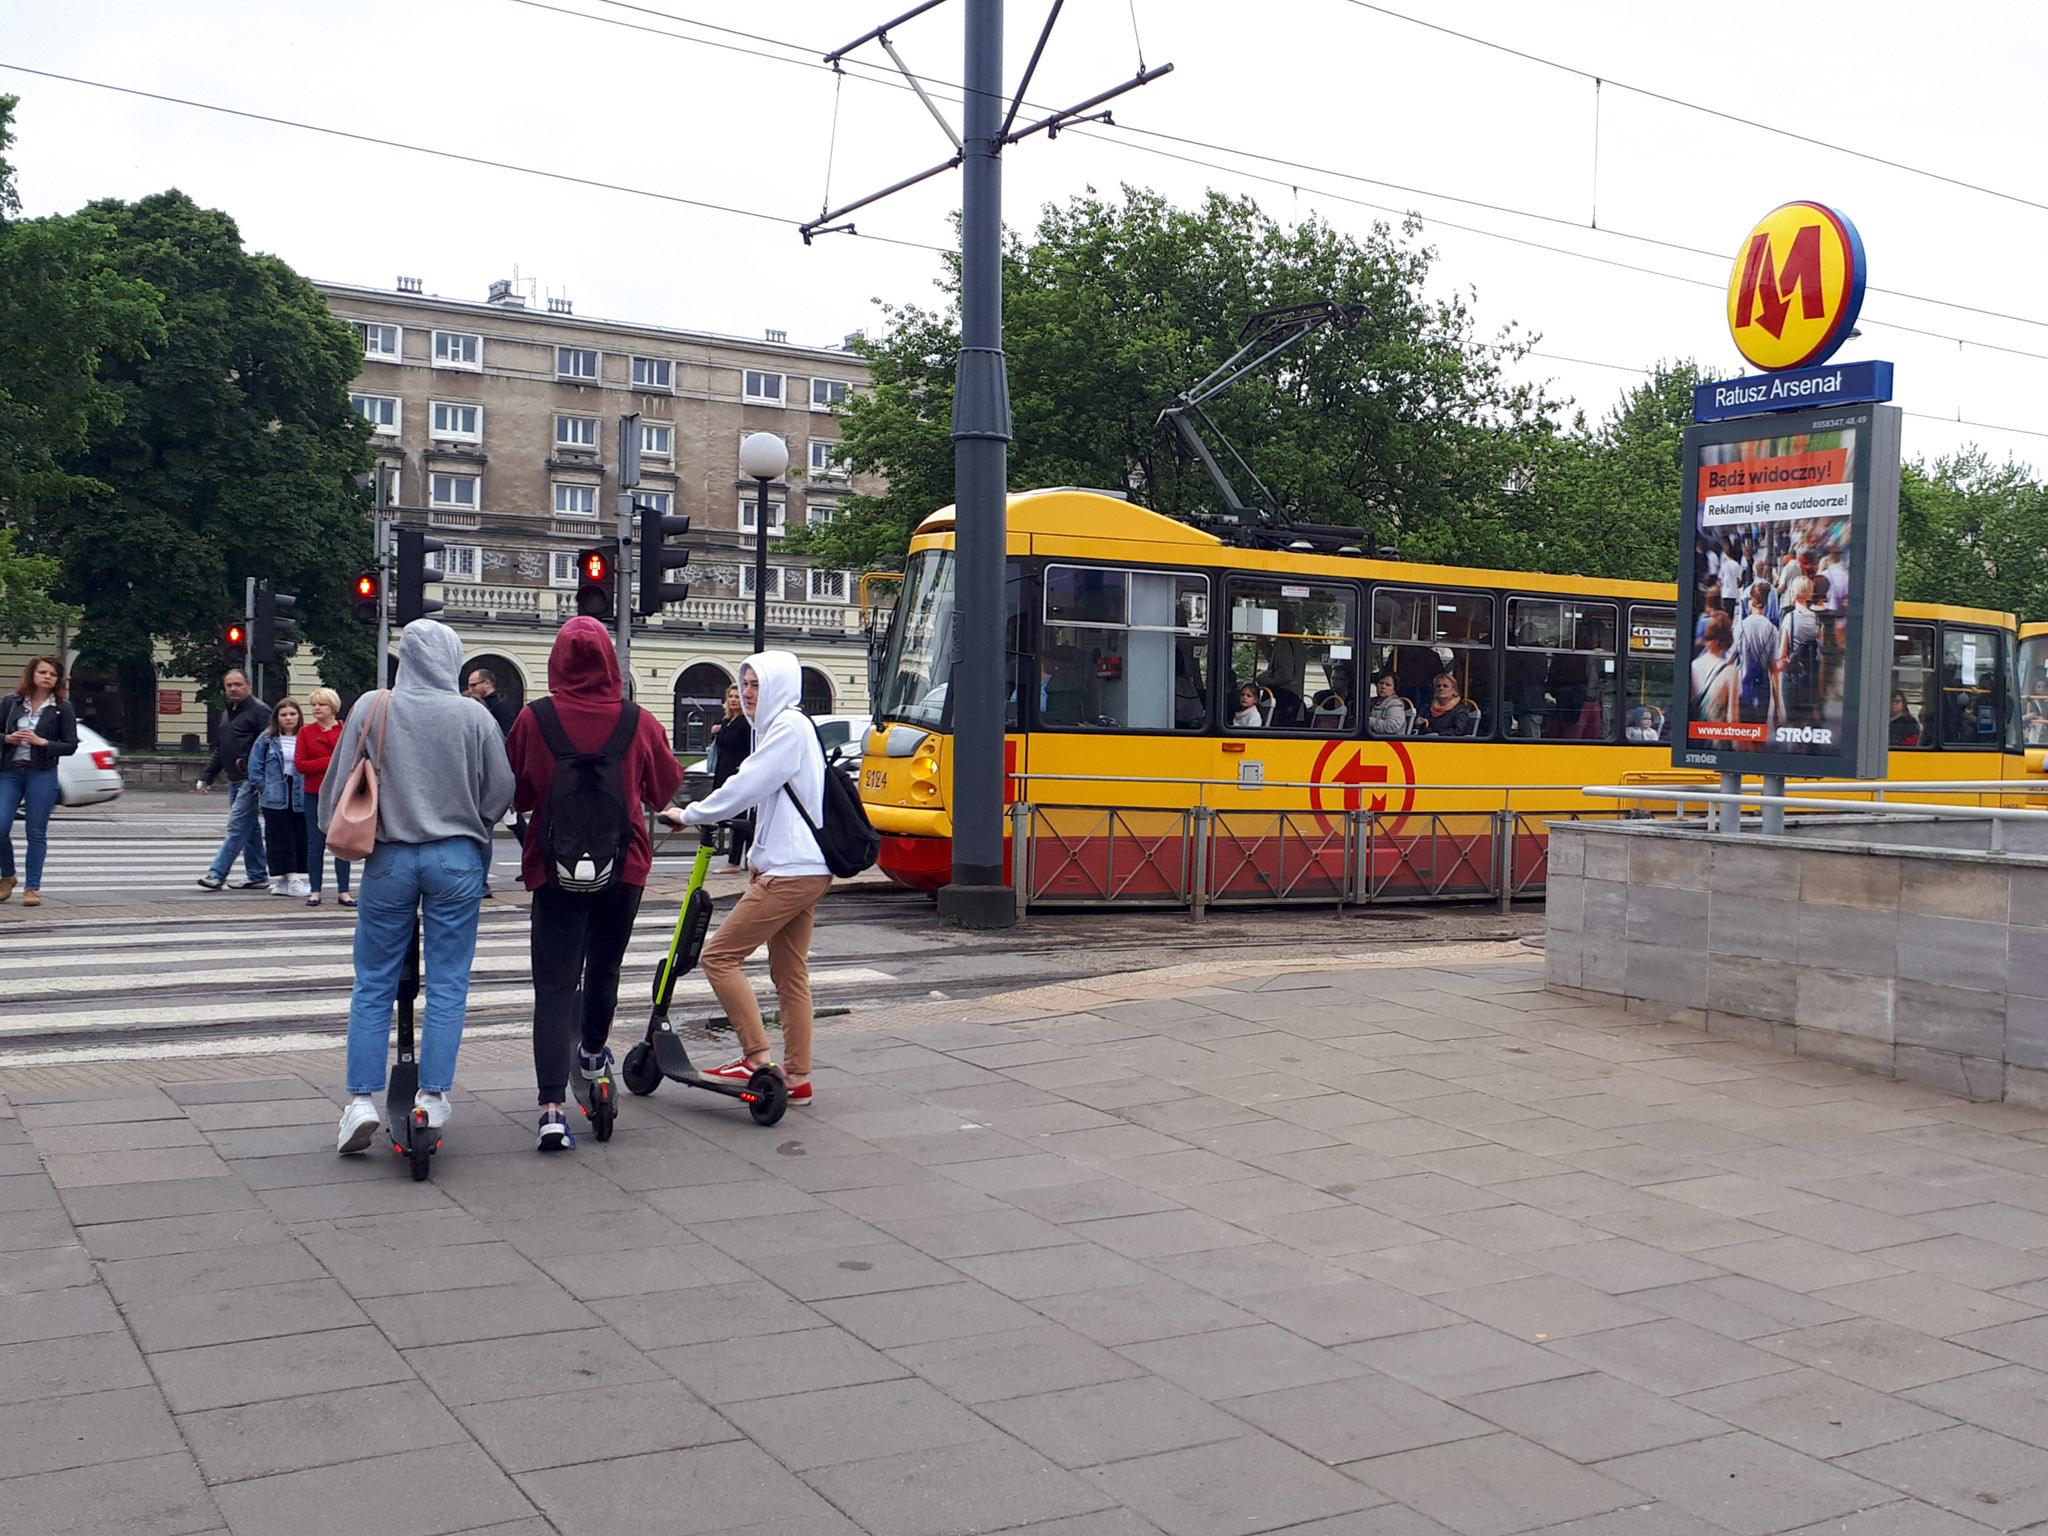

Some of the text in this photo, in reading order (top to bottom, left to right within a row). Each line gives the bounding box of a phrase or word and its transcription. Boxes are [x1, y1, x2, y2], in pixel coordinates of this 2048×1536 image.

[1715, 370, 1843, 408] Ratusz Arsenał
[1708, 460, 1832, 492] Bądź widoczny!
[1708, 494, 1848, 517] Reklamuj się na outdoorze!
[1698, 726, 1761, 740] www.stroer.pl
[866, 769, 888, 789] 2124
